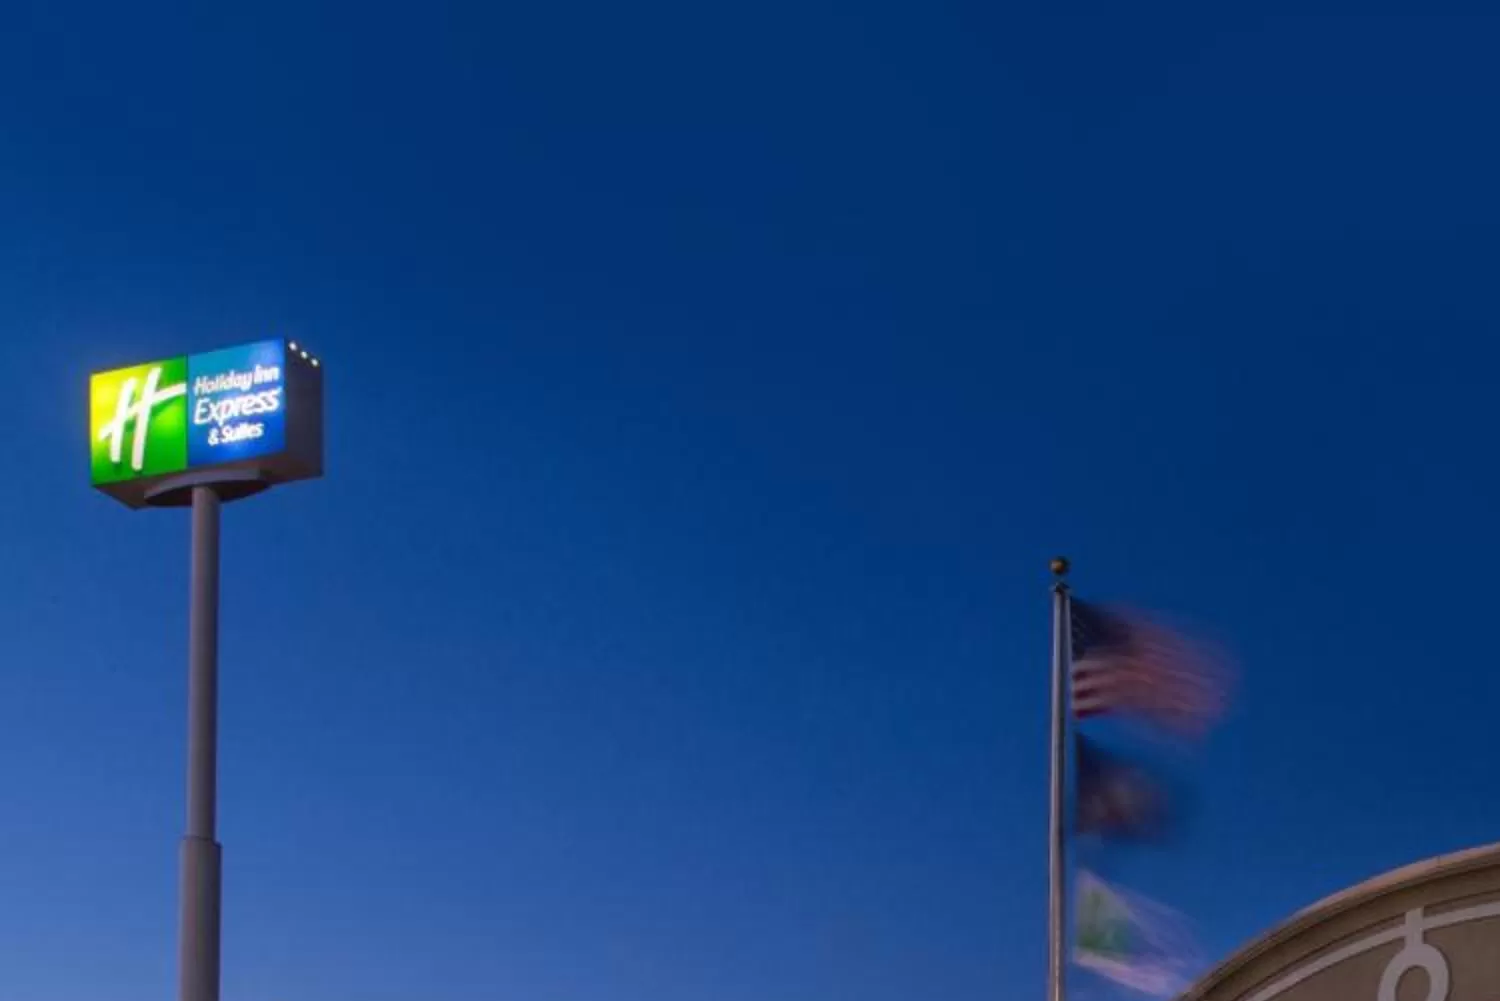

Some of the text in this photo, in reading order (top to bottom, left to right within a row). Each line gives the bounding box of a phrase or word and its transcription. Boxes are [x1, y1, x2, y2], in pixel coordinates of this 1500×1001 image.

[193, 363, 280, 397] Holiday Inn
[193, 386, 282, 426] Express
[208, 422, 264, 446] & Suites
